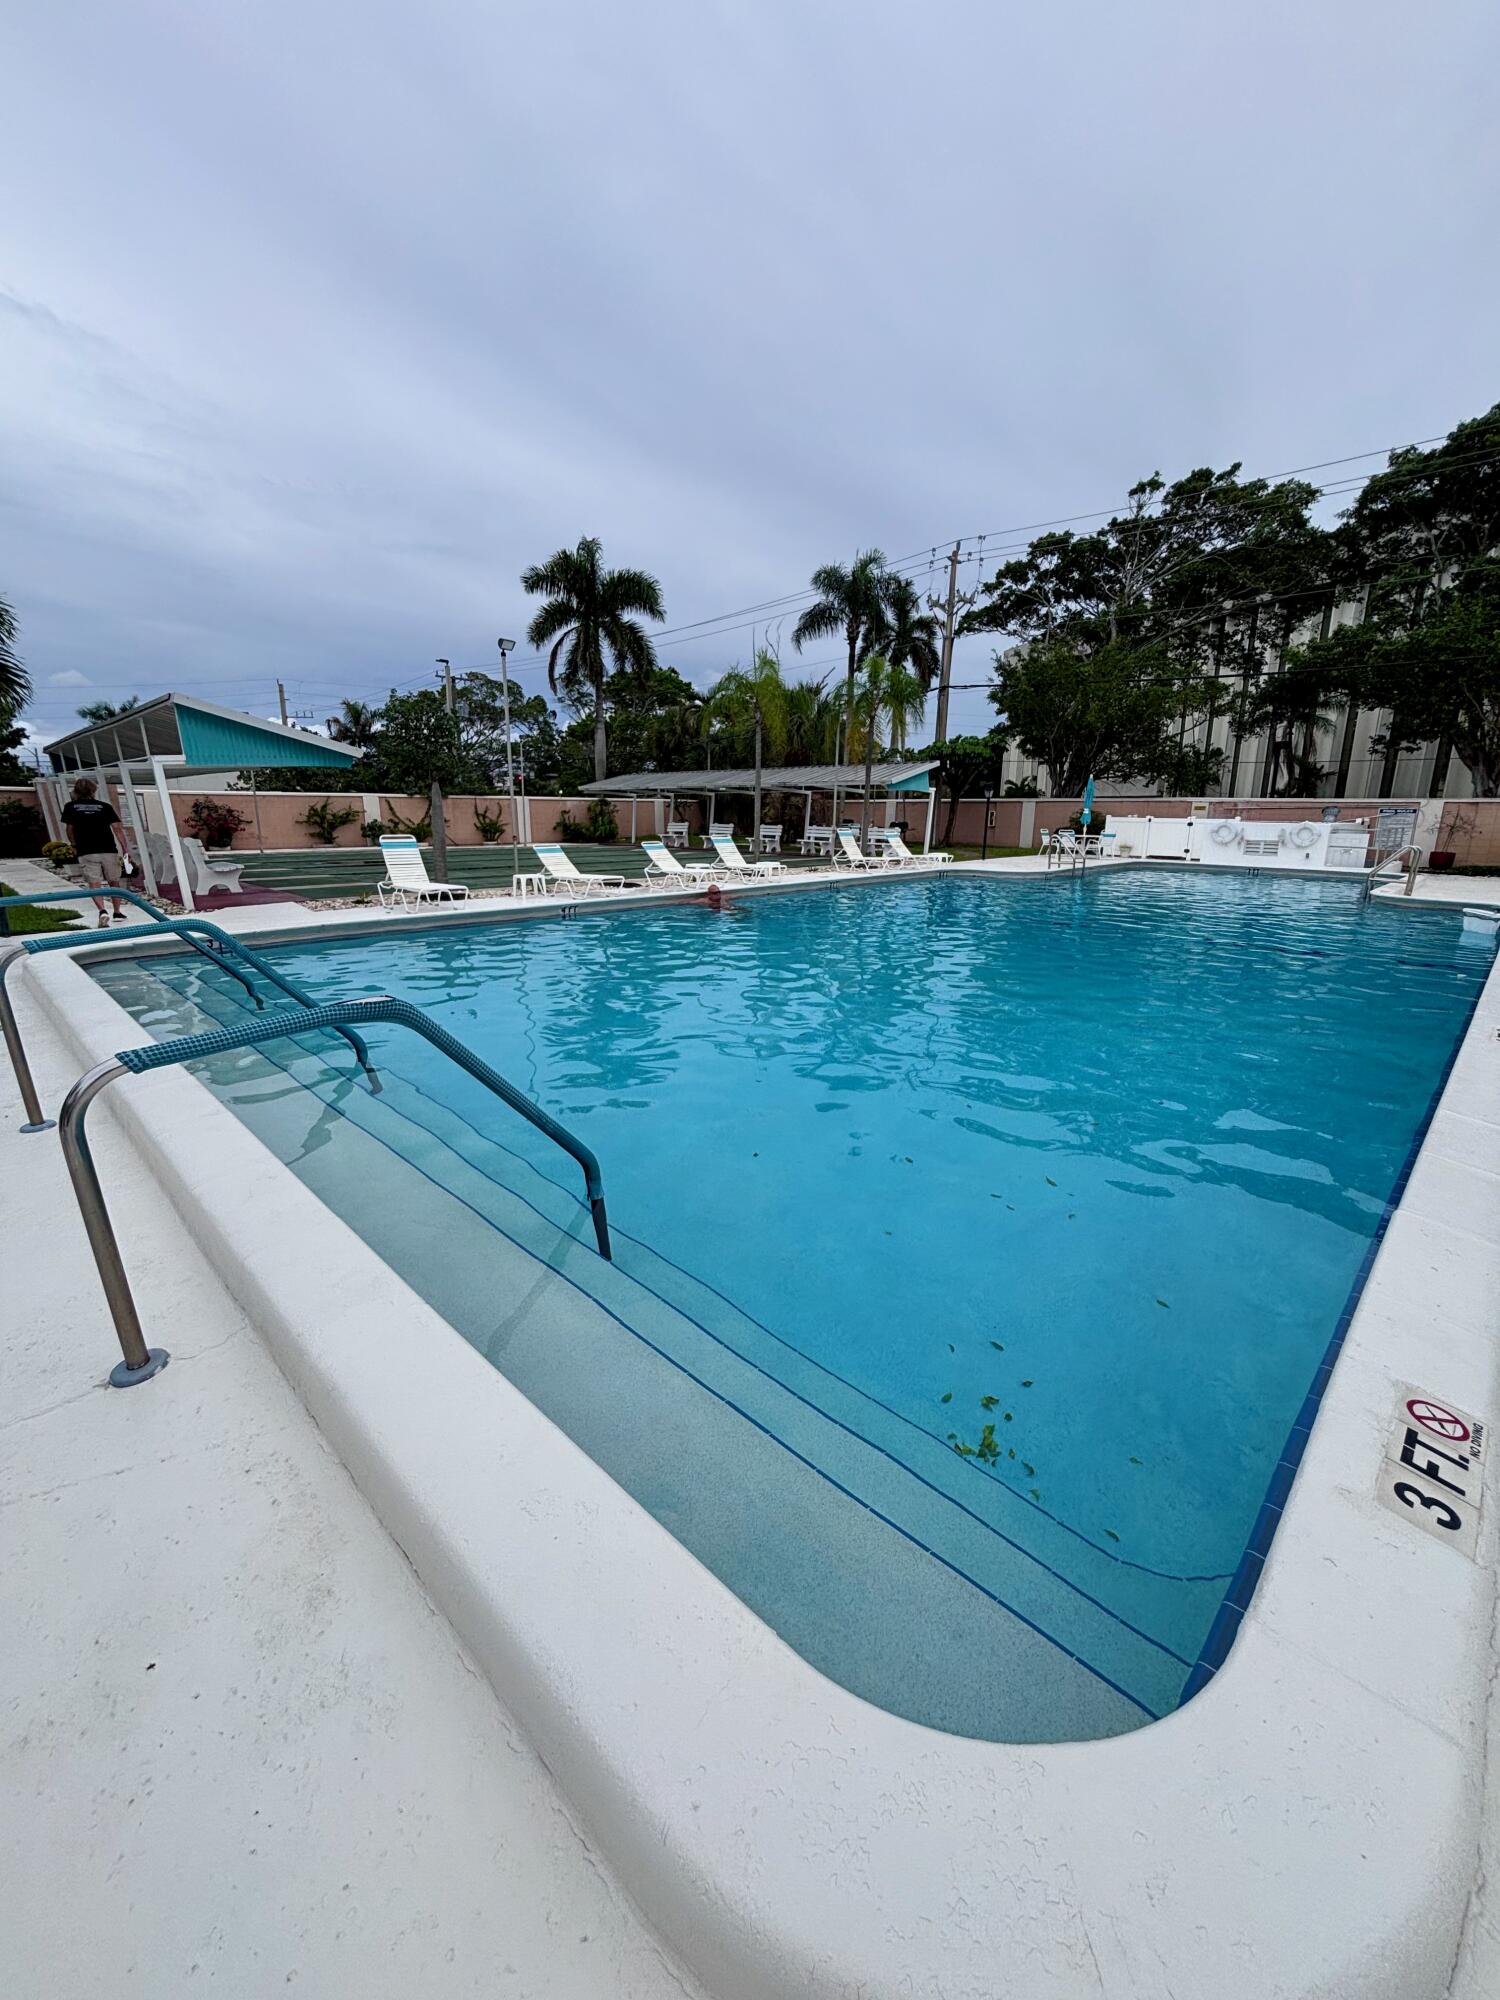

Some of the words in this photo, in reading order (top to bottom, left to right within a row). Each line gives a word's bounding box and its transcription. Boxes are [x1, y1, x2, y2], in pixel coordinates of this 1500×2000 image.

[1469, 1446, 1481, 1460] NO
[1470, 1422, 1484, 1447] DIVING
[1400, 1427, 1470, 1497] FT.
[1394, 1481, 1462, 1531] 3
